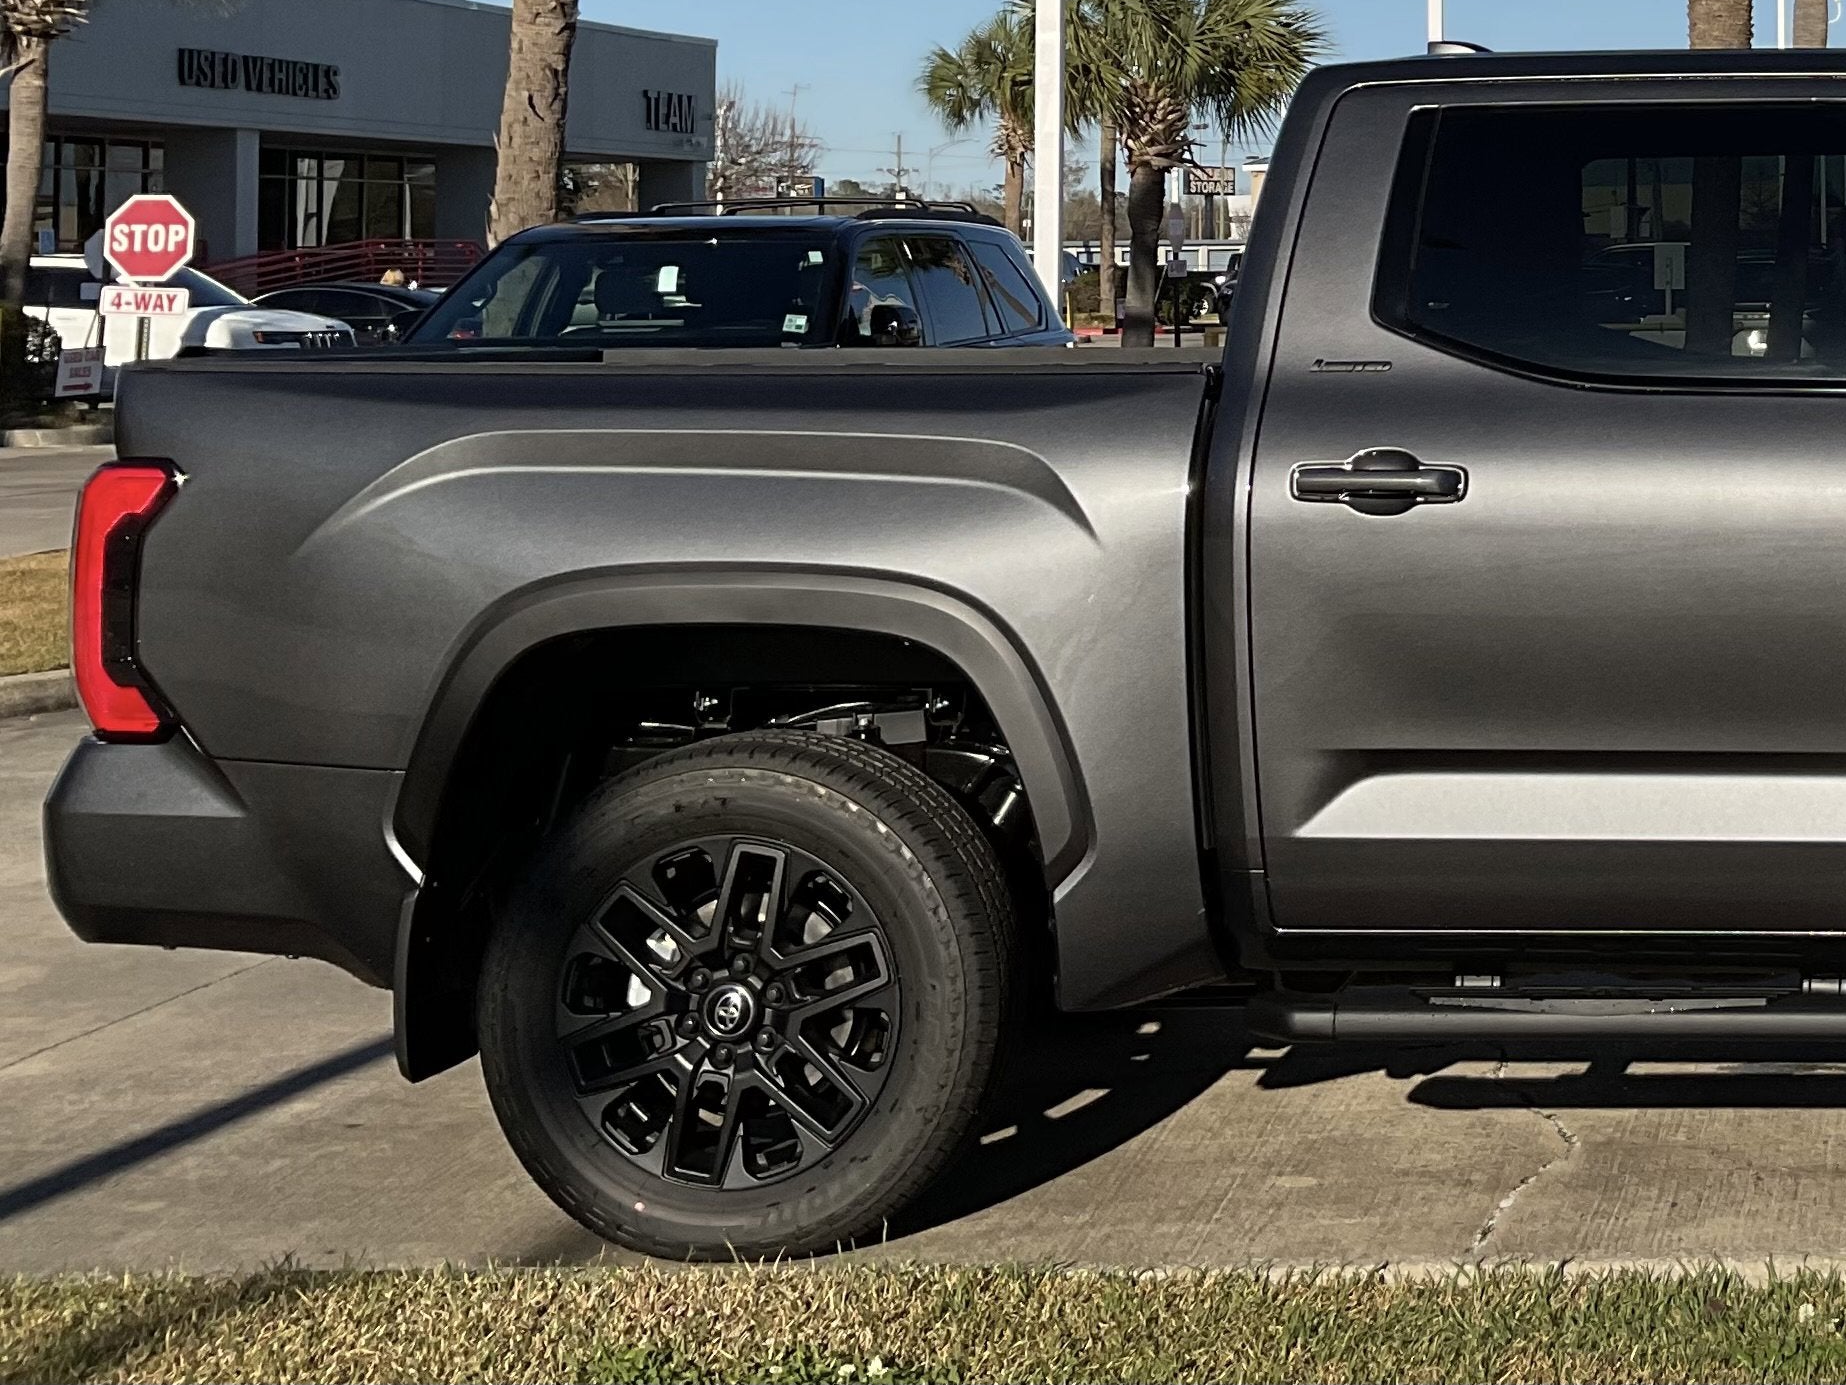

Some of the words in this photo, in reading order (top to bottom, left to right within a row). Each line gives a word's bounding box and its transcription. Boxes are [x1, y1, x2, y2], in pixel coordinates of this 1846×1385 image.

[179, 48, 241, 89] USED
[242, 55, 341, 100] VEHICLES
[643, 90, 697, 134] TEAM
[1189, 181, 1234, 194] STORAGE
[112, 223, 186, 253] STOP
[110, 292, 178, 312] 4-WAY
